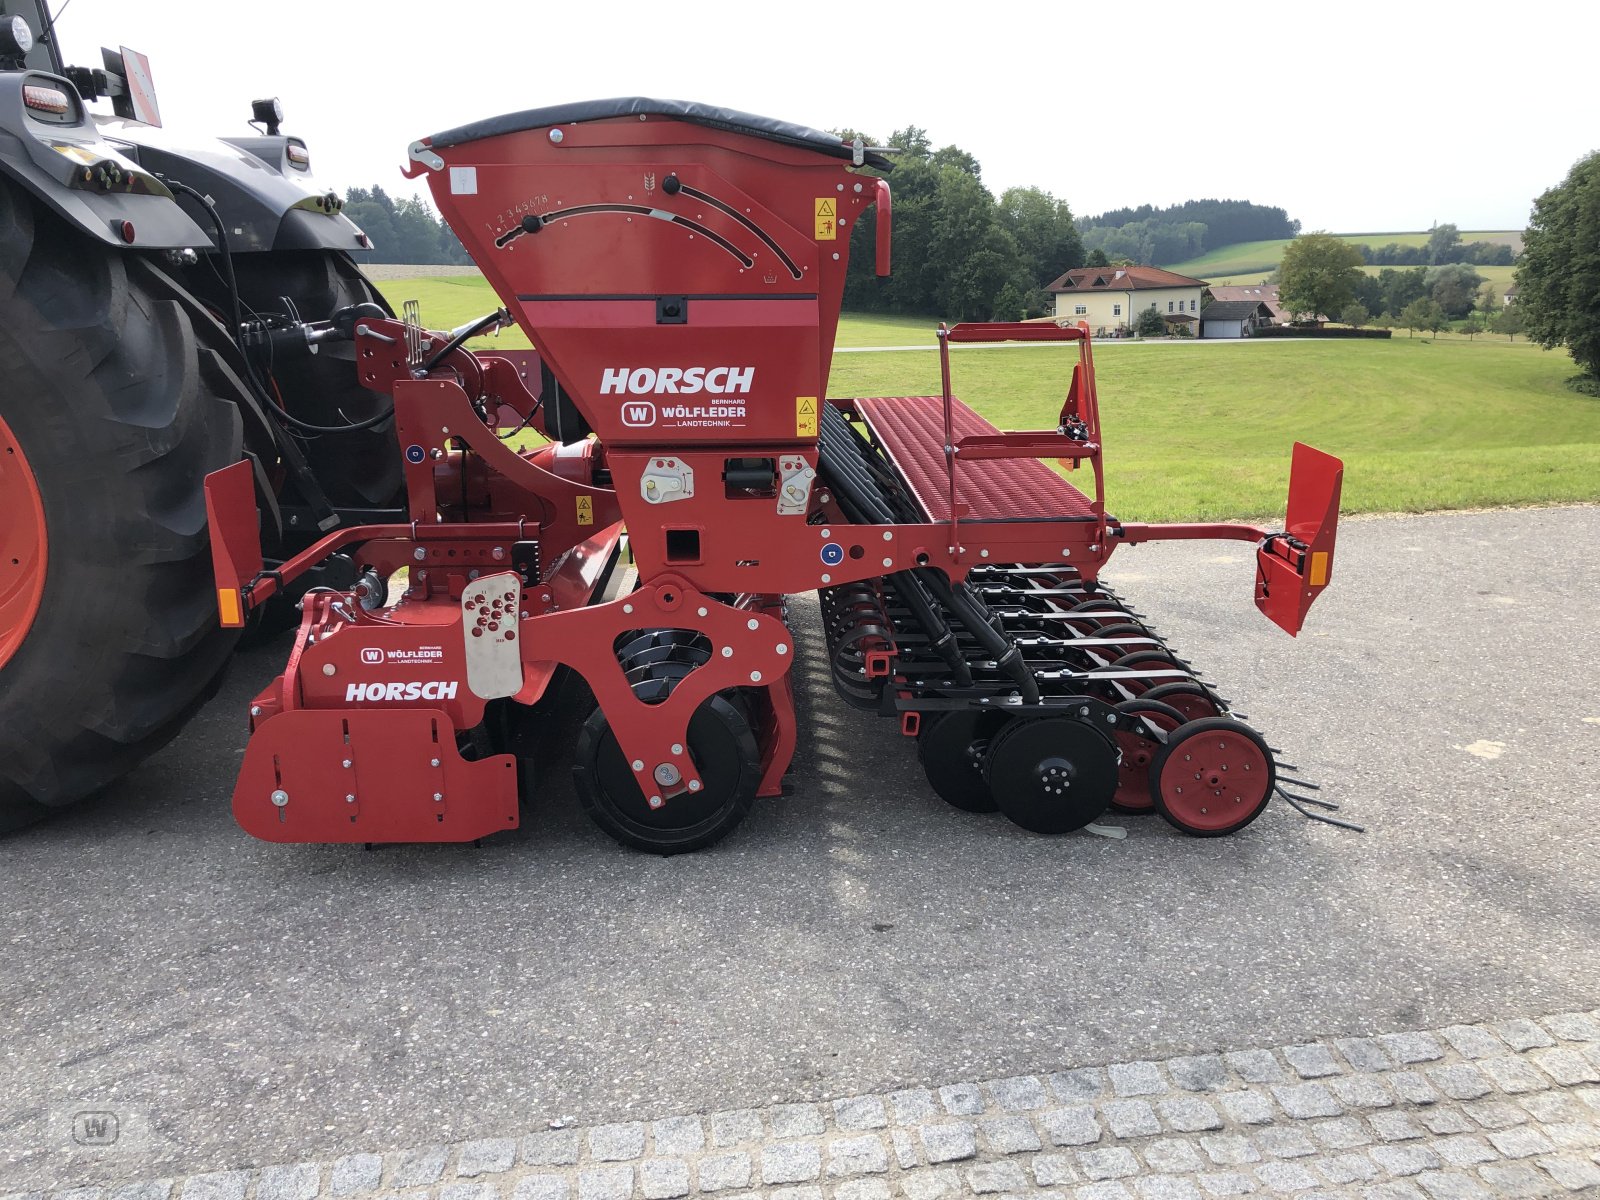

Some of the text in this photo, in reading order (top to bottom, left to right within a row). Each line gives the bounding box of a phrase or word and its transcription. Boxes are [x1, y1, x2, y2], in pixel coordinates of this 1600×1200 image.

[497, 214, 505, 224] 2
[507, 209, 514, 218] 3
[515, 204, 522, 213] 4
[521, 201, 529, 211] 5
[541, 194, 548, 203] 8
[599, 366, 756, 395] HORSCH
[629, 405, 746, 422] W WÖLFLEDER
[365, 649, 443, 661] W WÖLFLEDER
[345, 681, 458, 701] HORSCH
